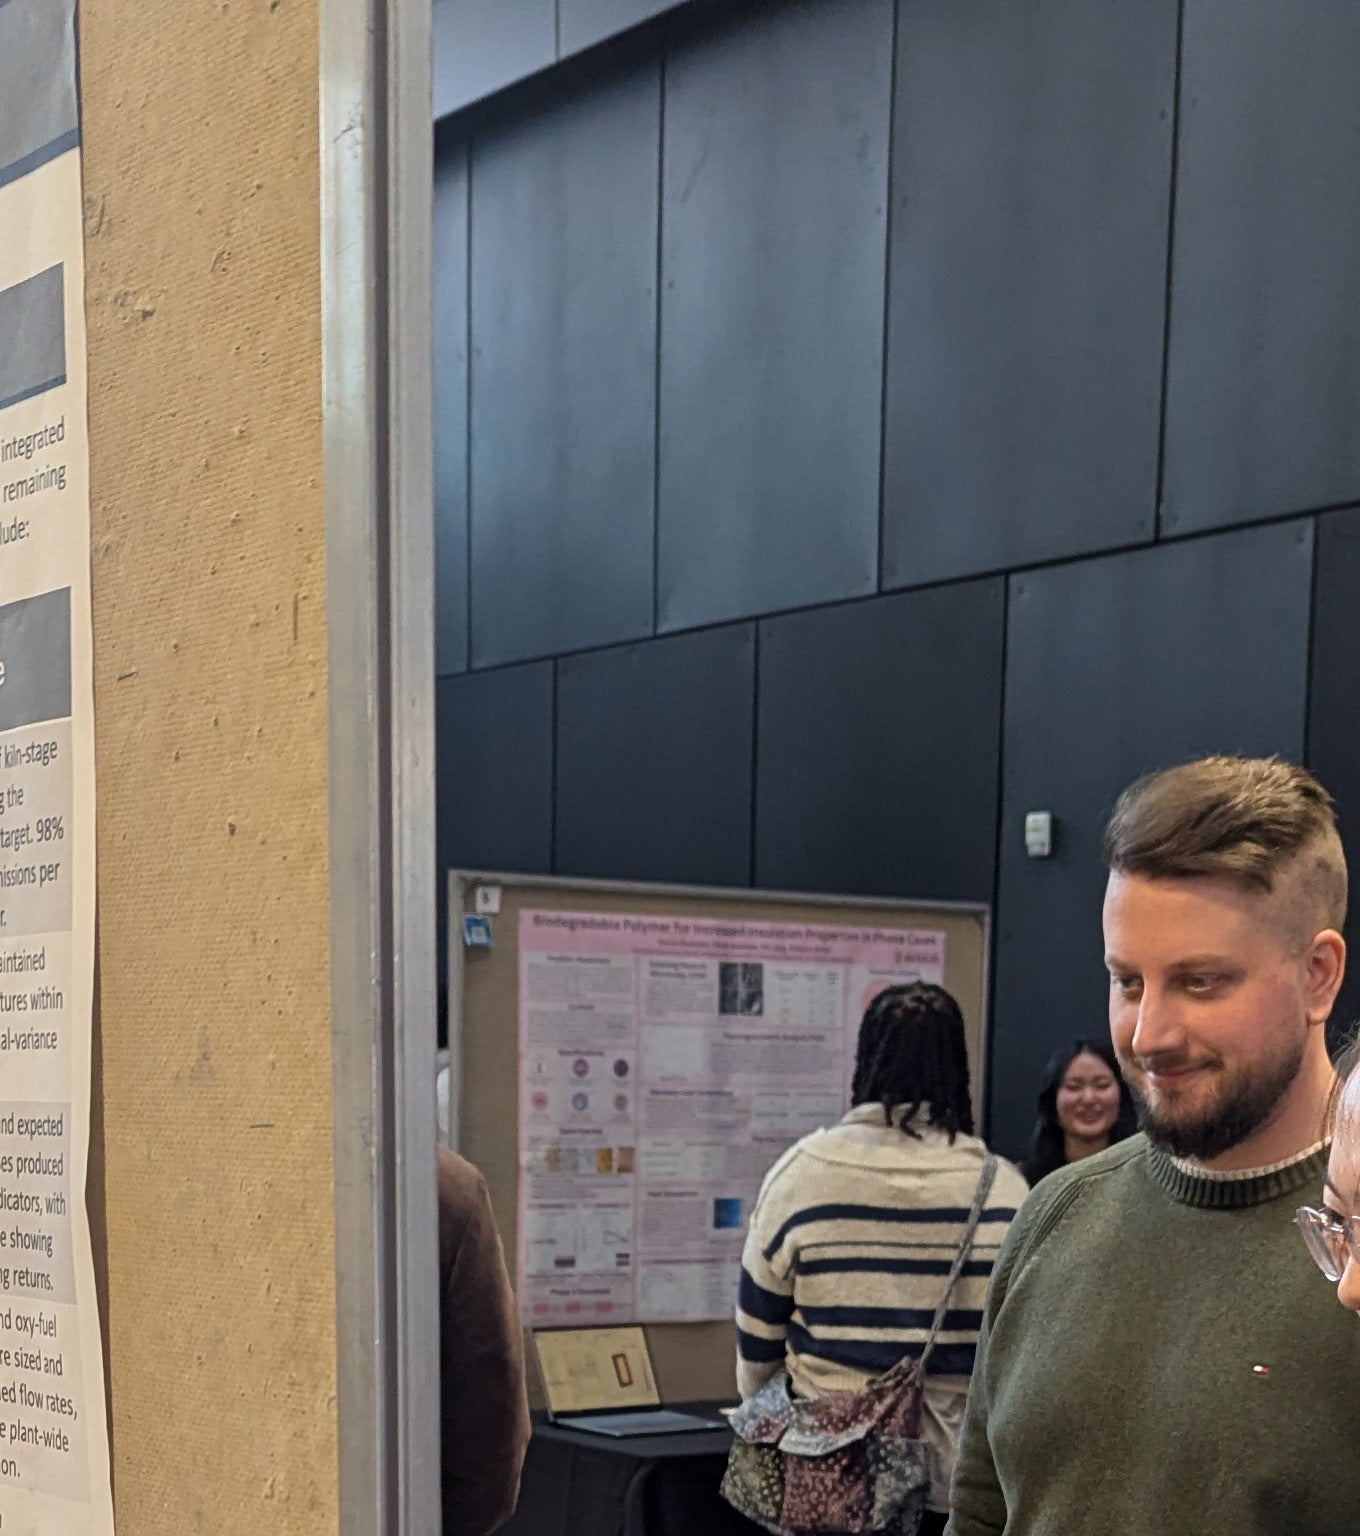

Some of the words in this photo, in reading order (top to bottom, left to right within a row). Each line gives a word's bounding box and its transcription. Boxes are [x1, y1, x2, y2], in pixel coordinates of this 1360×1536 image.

[1, 416, 65, 461] integrated
[3, 465, 66, 504] remaining
[4, 739, 58, 768] kiln-stage
[7, 785, 23, 807] the
[0, 821, 33, 846] target.
[36, 816, 64, 841] 98%
[40, 862, 60, 883] per
